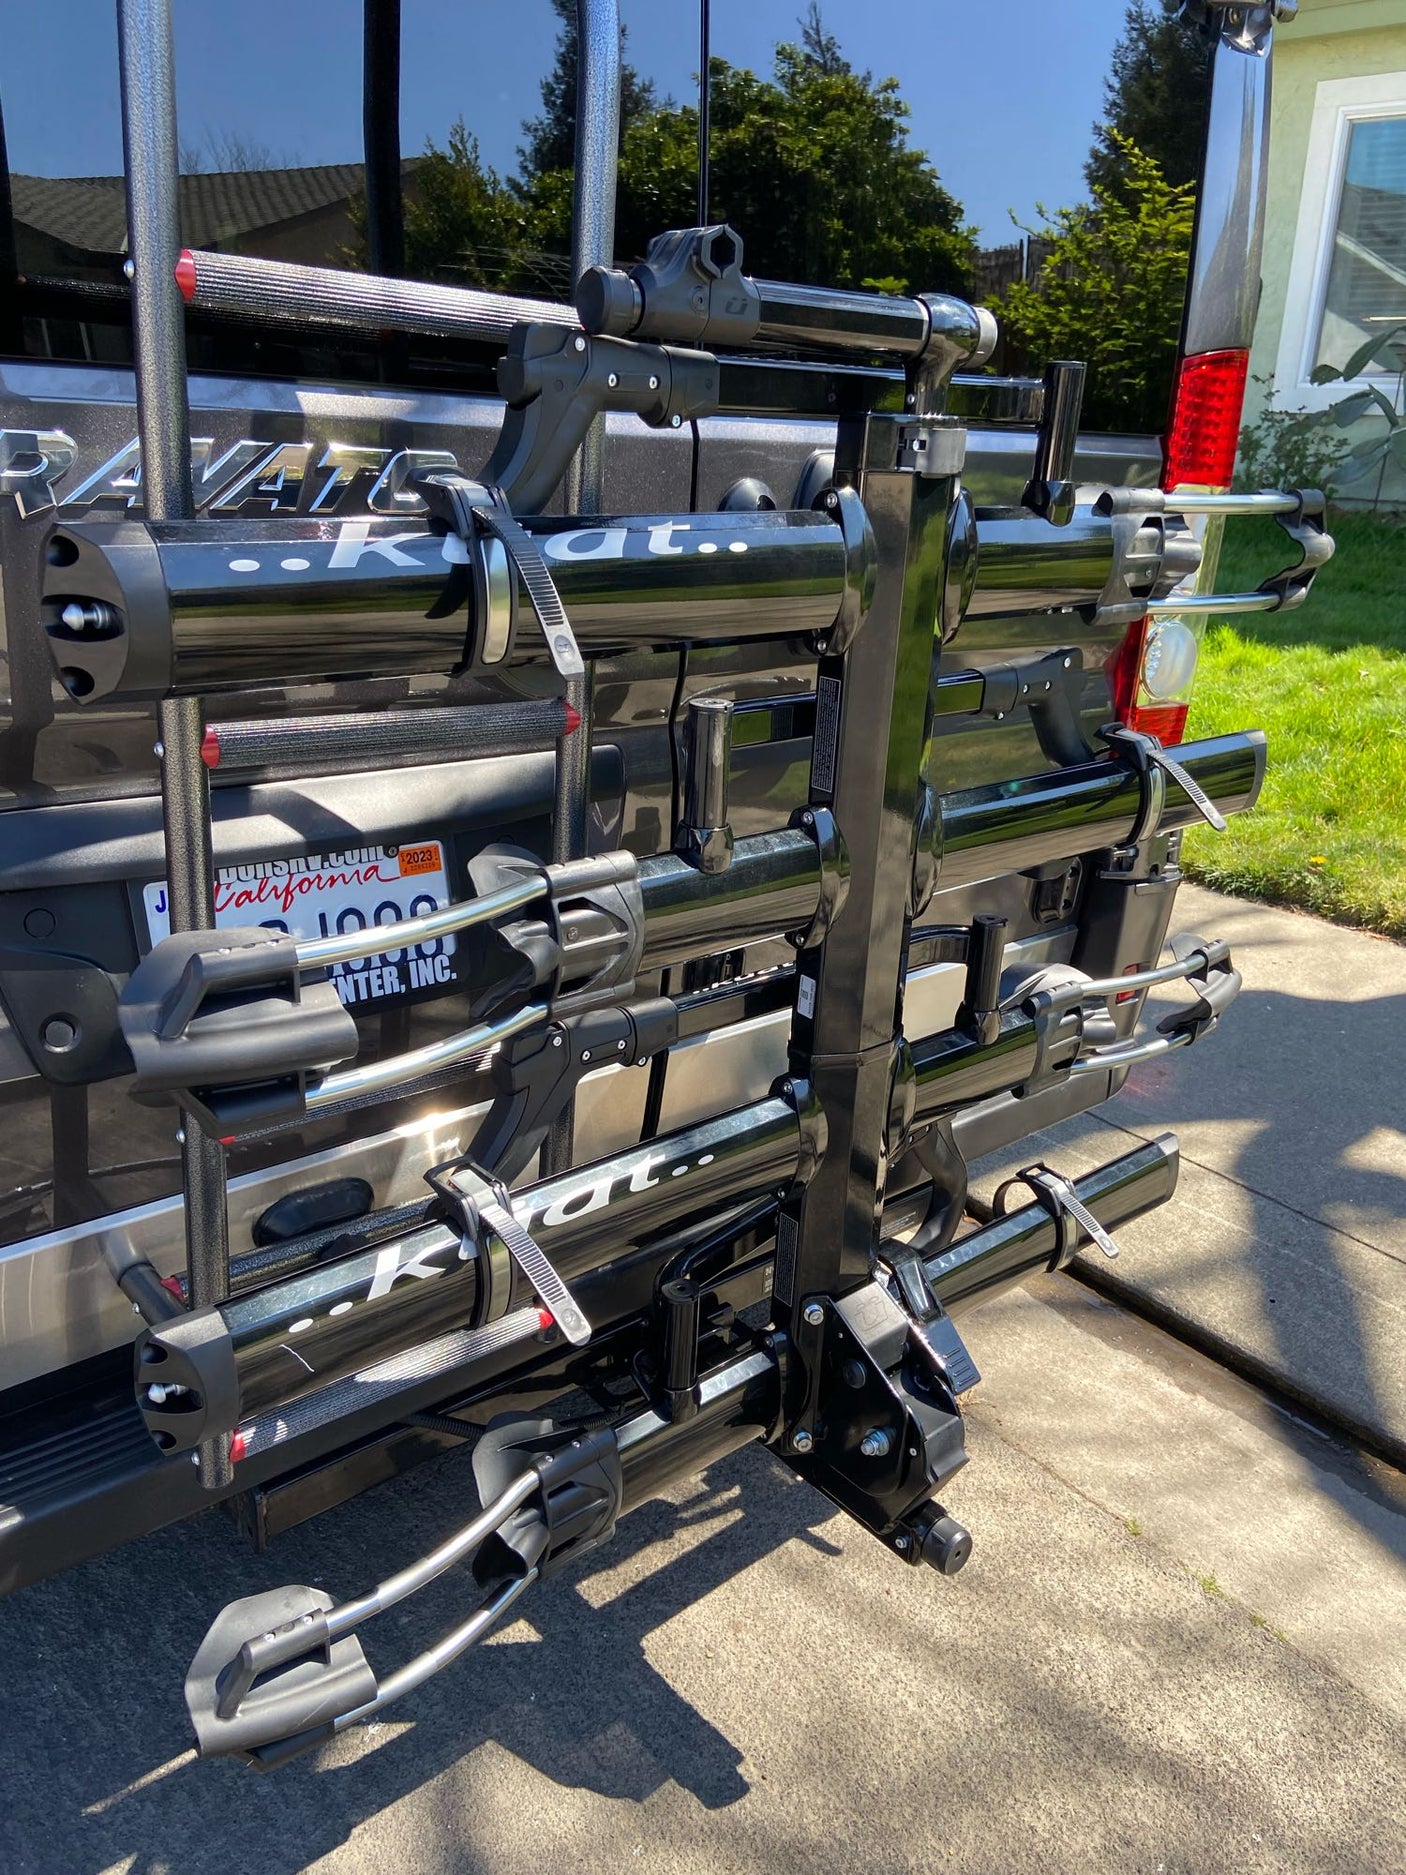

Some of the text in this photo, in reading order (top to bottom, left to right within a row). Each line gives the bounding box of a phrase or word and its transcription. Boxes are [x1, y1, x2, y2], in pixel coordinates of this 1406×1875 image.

[405, 850, 433, 865] 2023
[214, 864, 401, 913] California
[329, 954, 457, 1005] NTER, INC.
